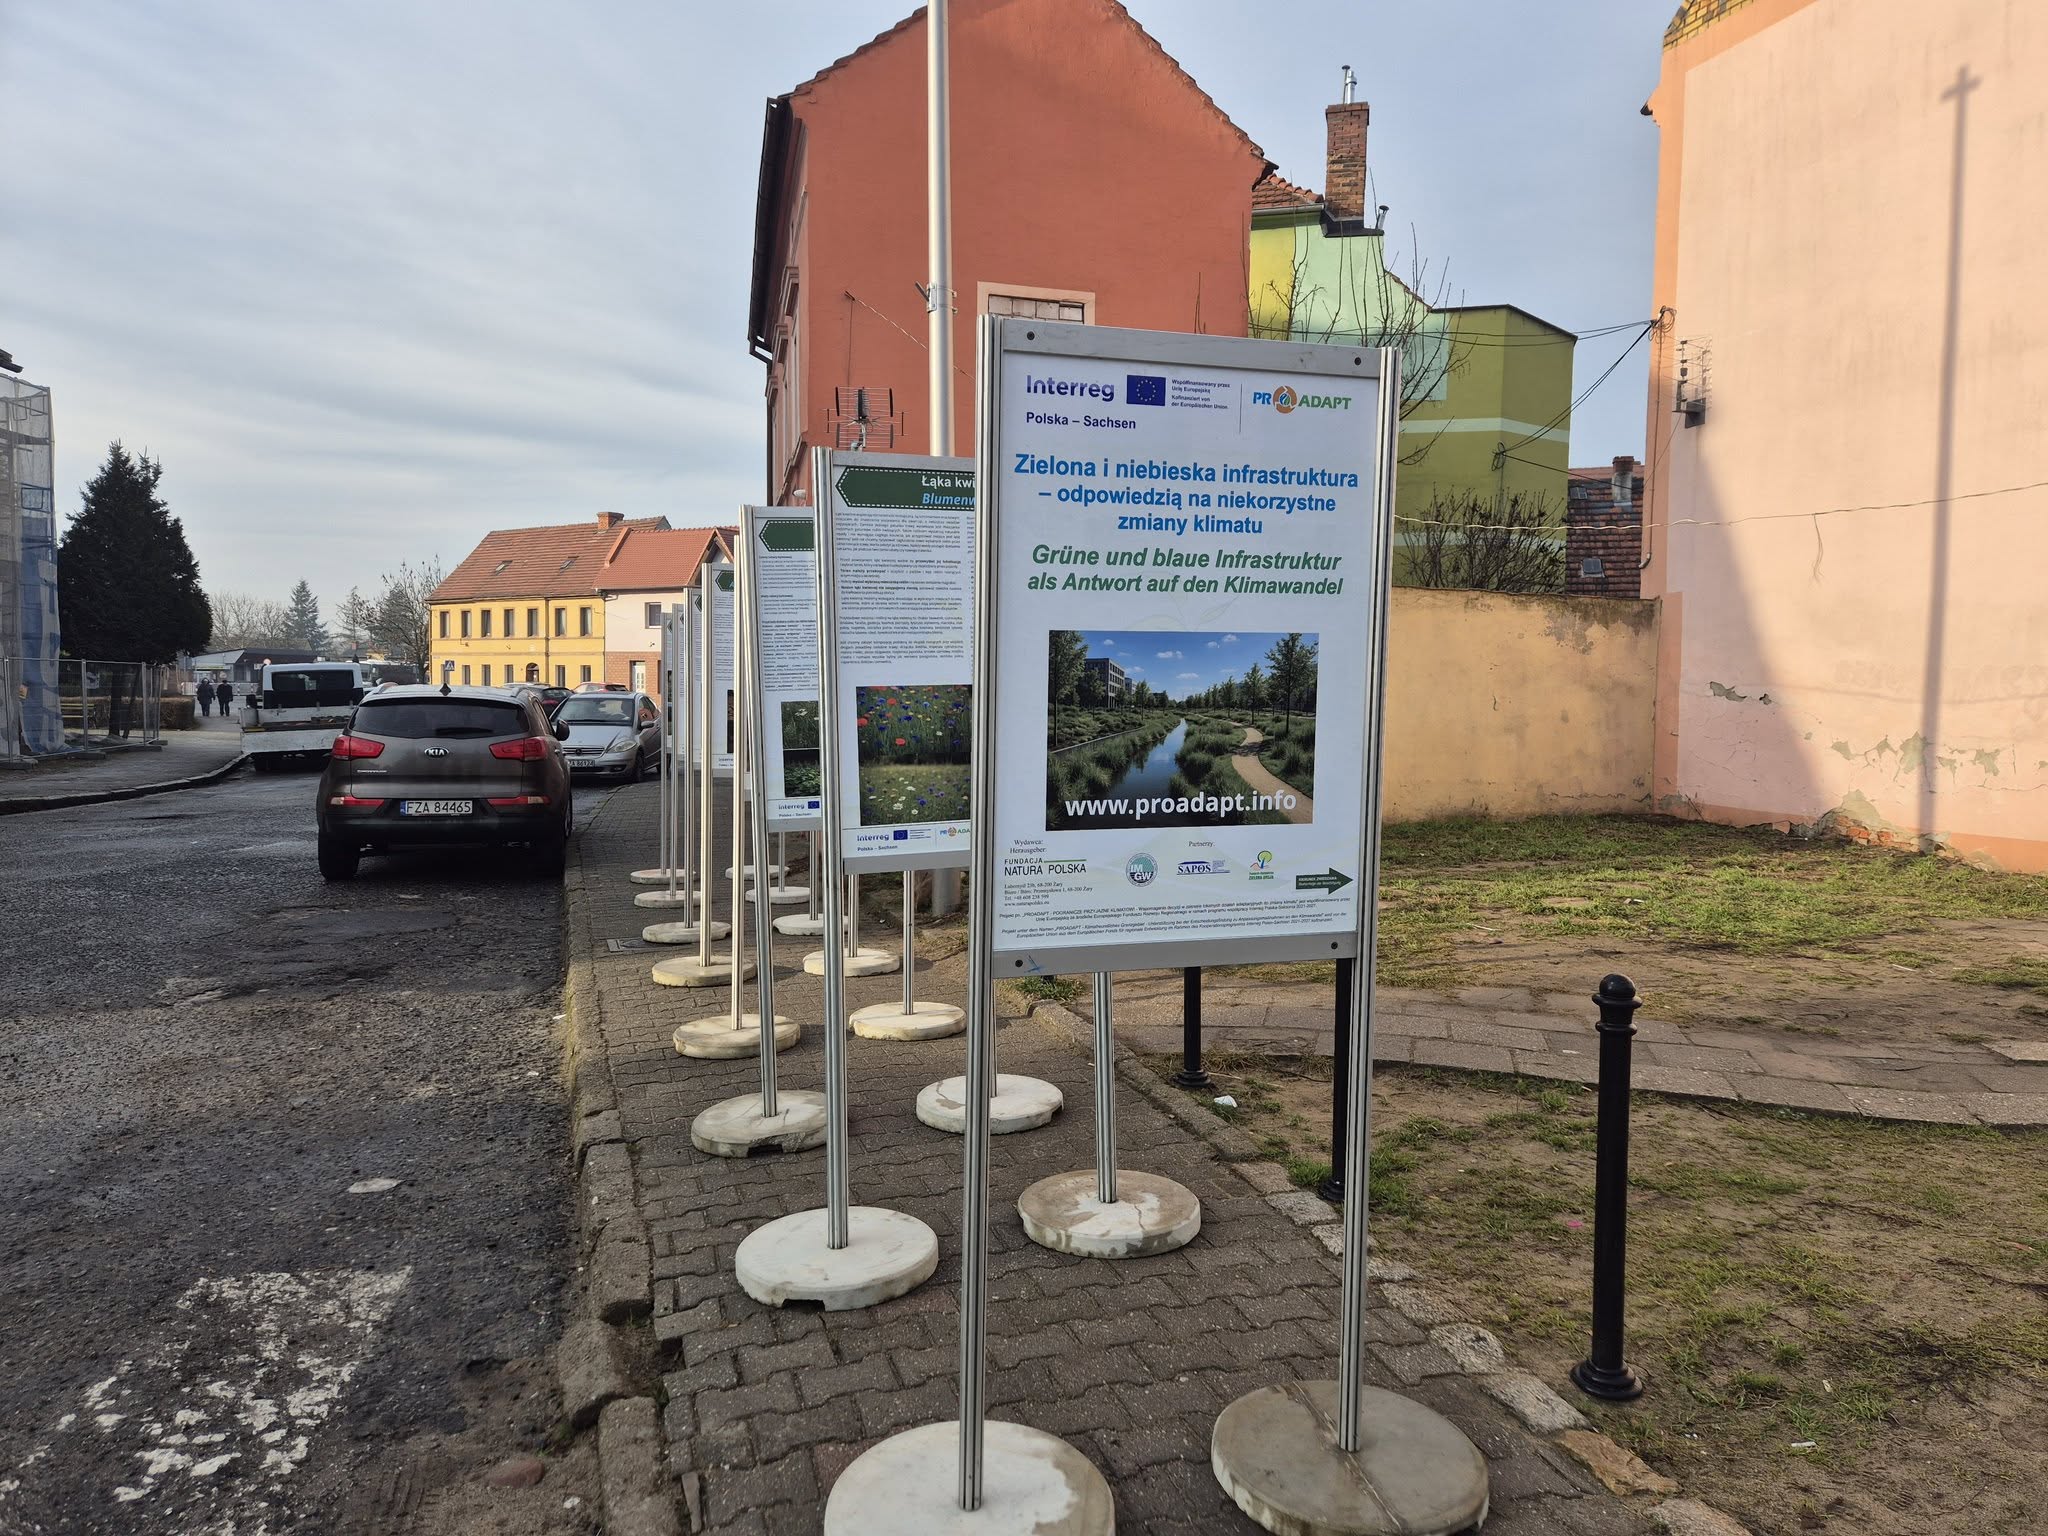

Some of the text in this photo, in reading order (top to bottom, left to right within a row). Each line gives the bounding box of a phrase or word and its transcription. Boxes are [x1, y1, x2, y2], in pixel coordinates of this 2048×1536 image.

[1026, 374, 1114, 402] Interreg
[1026, 412, 1068, 425] Polska
[1083, 415, 1136, 429] Sachsen
[922, 475, 951, 489] Łąka
[1014, 454, 1358, 488] Zielona i niebieska infrastruktura
[1057, 484, 1183, 510] odpowiedzią
[1188, 492, 1211, 507] na
[1217, 490, 1336, 515] niekorzystne
[1118, 512, 1263, 536] zmiany klimatu
[1032, 544, 1342, 570] Grüne und blaue Infrastruktur
[1027, 572, 1344, 595] als Antwort auf den Klimawandel
[406, 802, 471, 814] FZA 84465
[1065, 790, 1297, 820] www.proadapt.info
[1004, 864, 1086, 876] NATURA POLSKA
[1178, 864, 1211, 874] SAPOS
